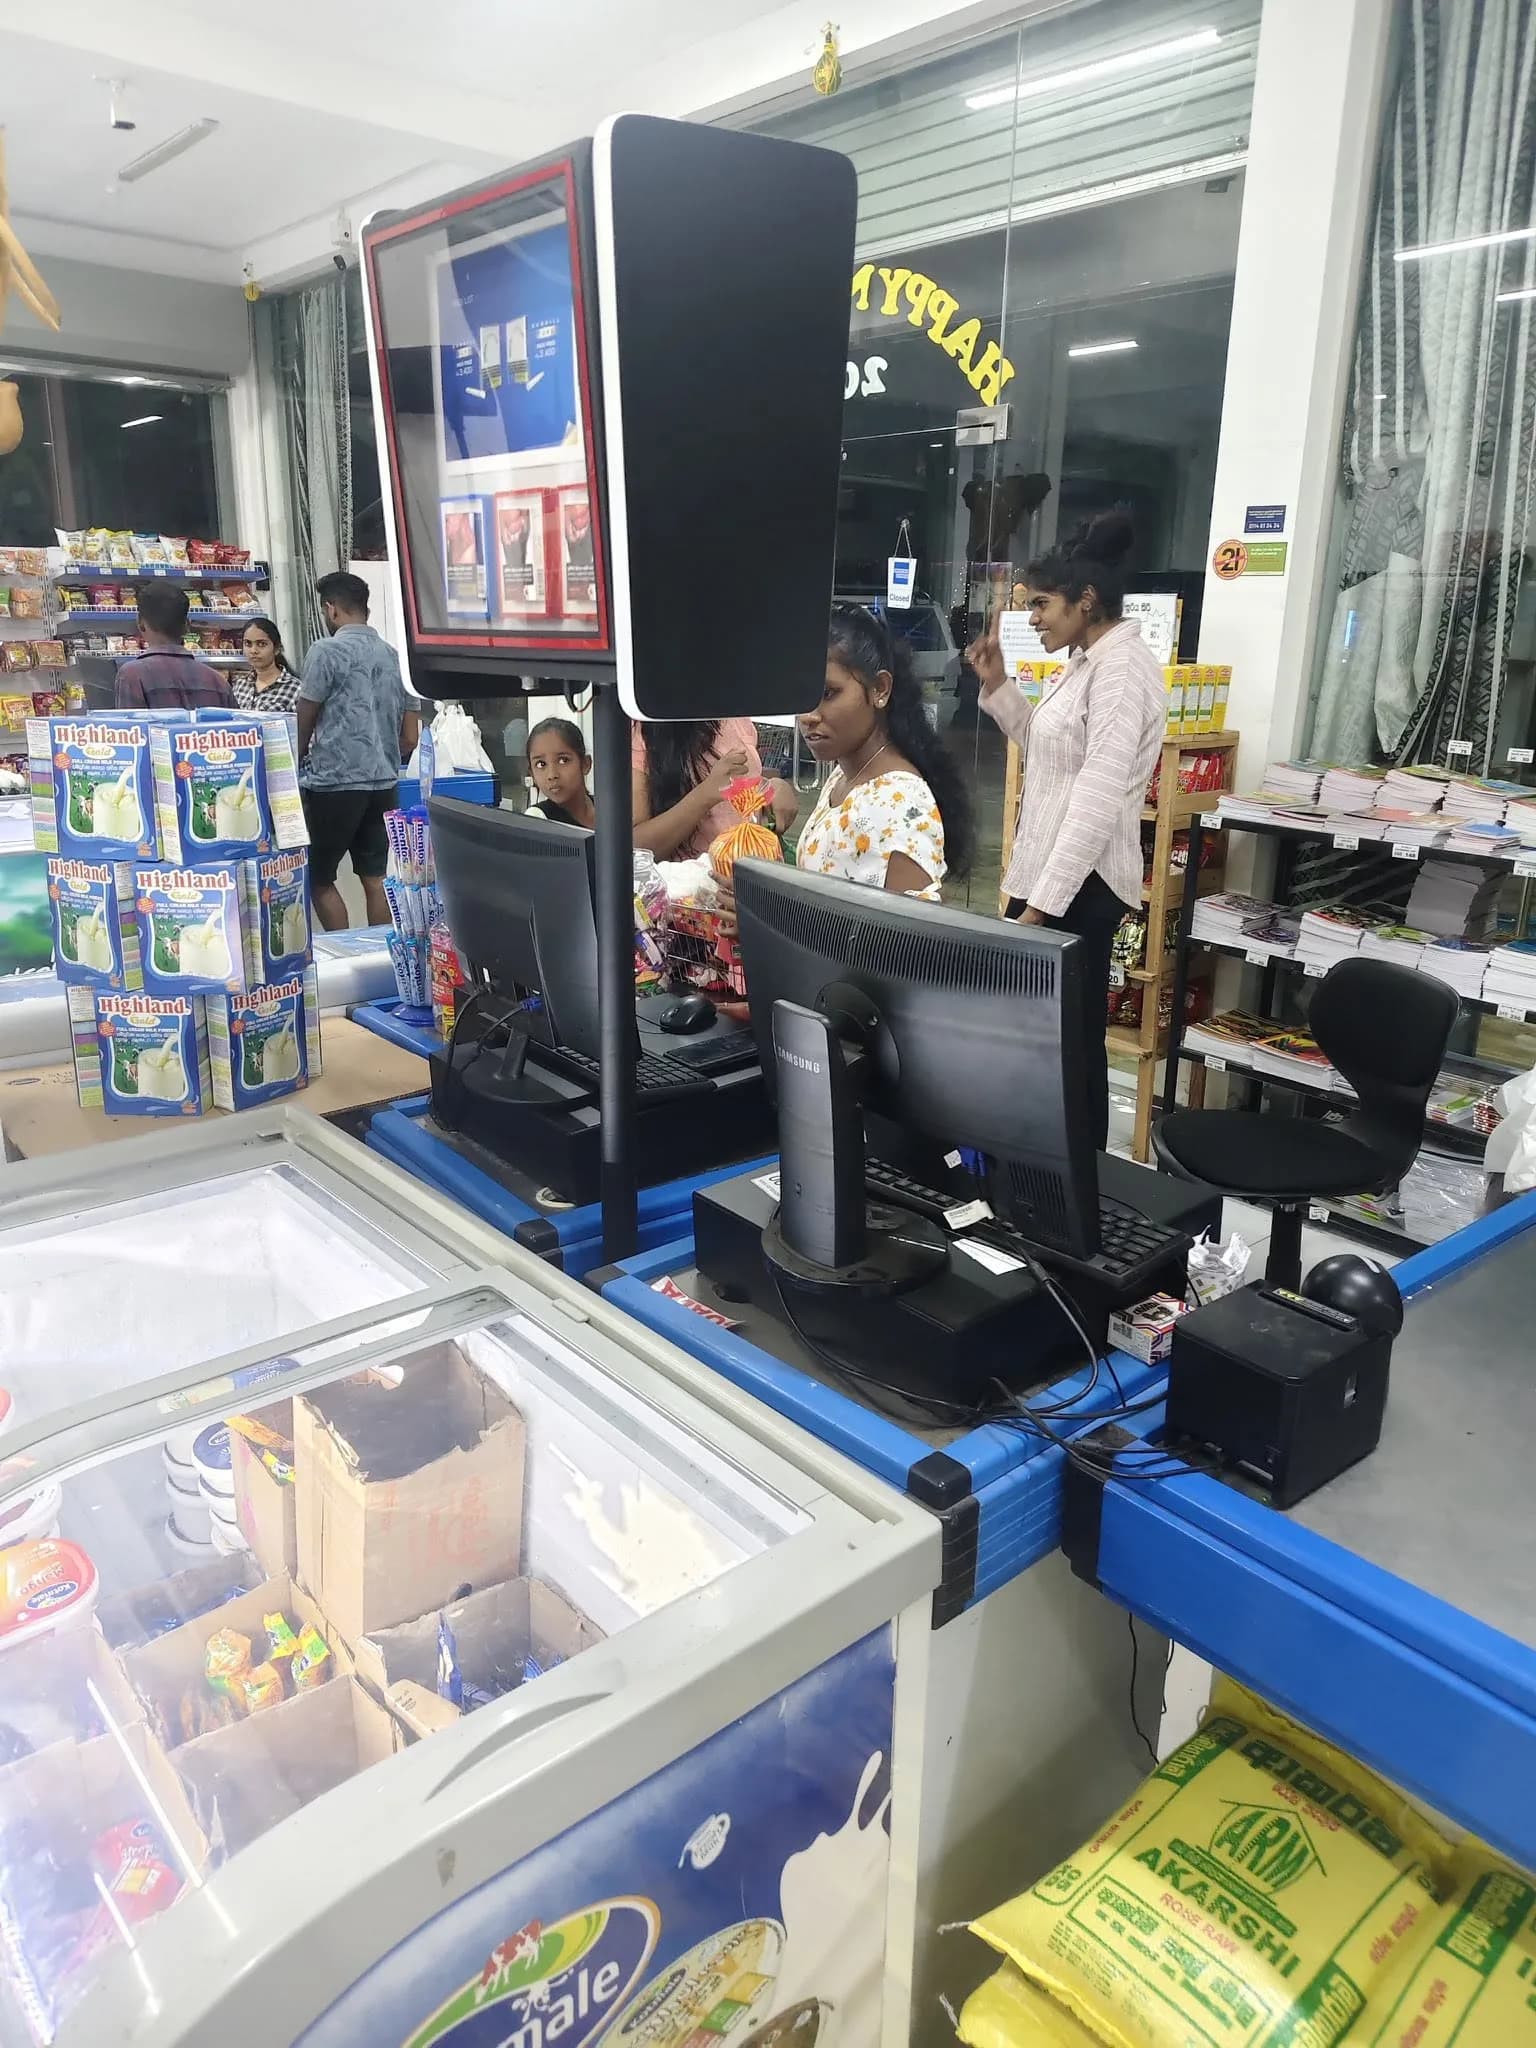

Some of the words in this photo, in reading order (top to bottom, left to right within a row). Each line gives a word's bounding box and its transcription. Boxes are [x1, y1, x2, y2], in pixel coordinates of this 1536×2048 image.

[888, 592, 910, 603] Closed
[56, 724, 141, 747] Highland
[178, 729, 258, 752] Highland
[417, 822, 425, 866] mentos
[50, 860, 109, 883] Highland
[261, 850, 305, 878] Highland
[138, 871, 230, 891] Highland
[101, 997, 187, 1015] Highland
[234, 979, 299, 1011] Highland
[777, 1046, 821, 1074] SAMSUNG
[1215, 1809, 1309, 1890] ARM
[1133, 1846, 1301, 1978] AKARSHI
[1159, 1893, 1201, 1927] ROSE
[1201, 1924, 1241, 1954] RAW
